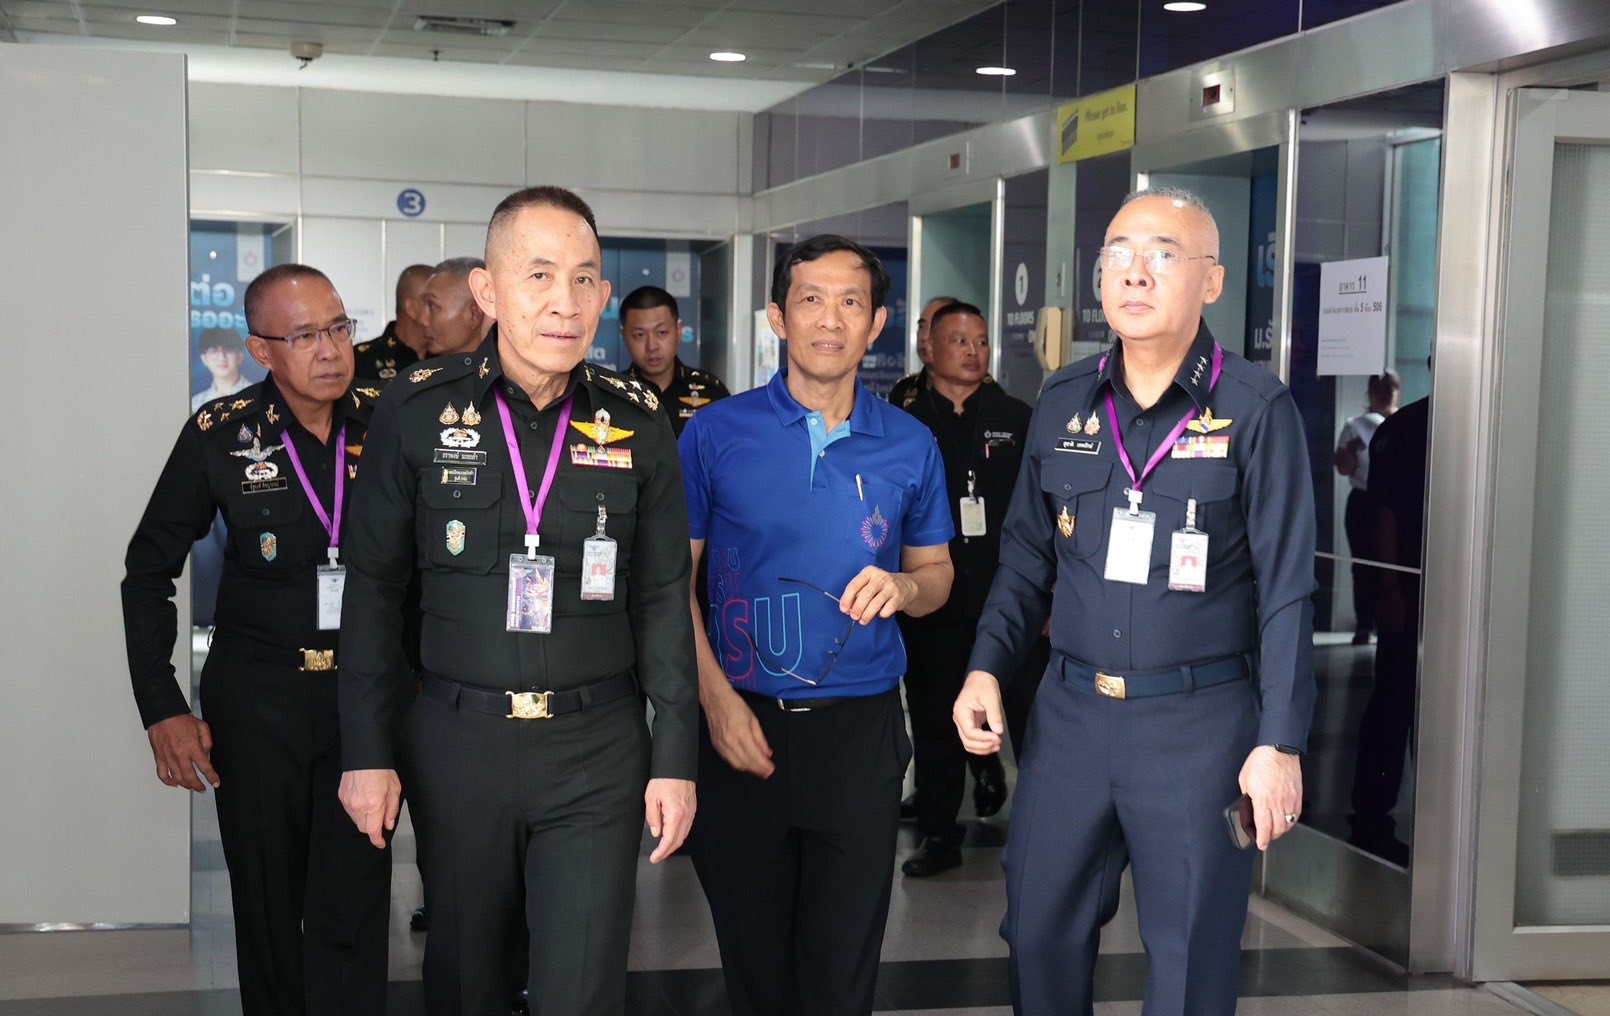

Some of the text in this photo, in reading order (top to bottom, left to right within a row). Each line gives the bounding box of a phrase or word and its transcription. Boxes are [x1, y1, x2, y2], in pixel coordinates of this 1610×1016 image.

[1358, 275, 1367, 290] 11
[1083, 309, 1105, 323] TO FLO
[709, 592, 802, 681] SU
